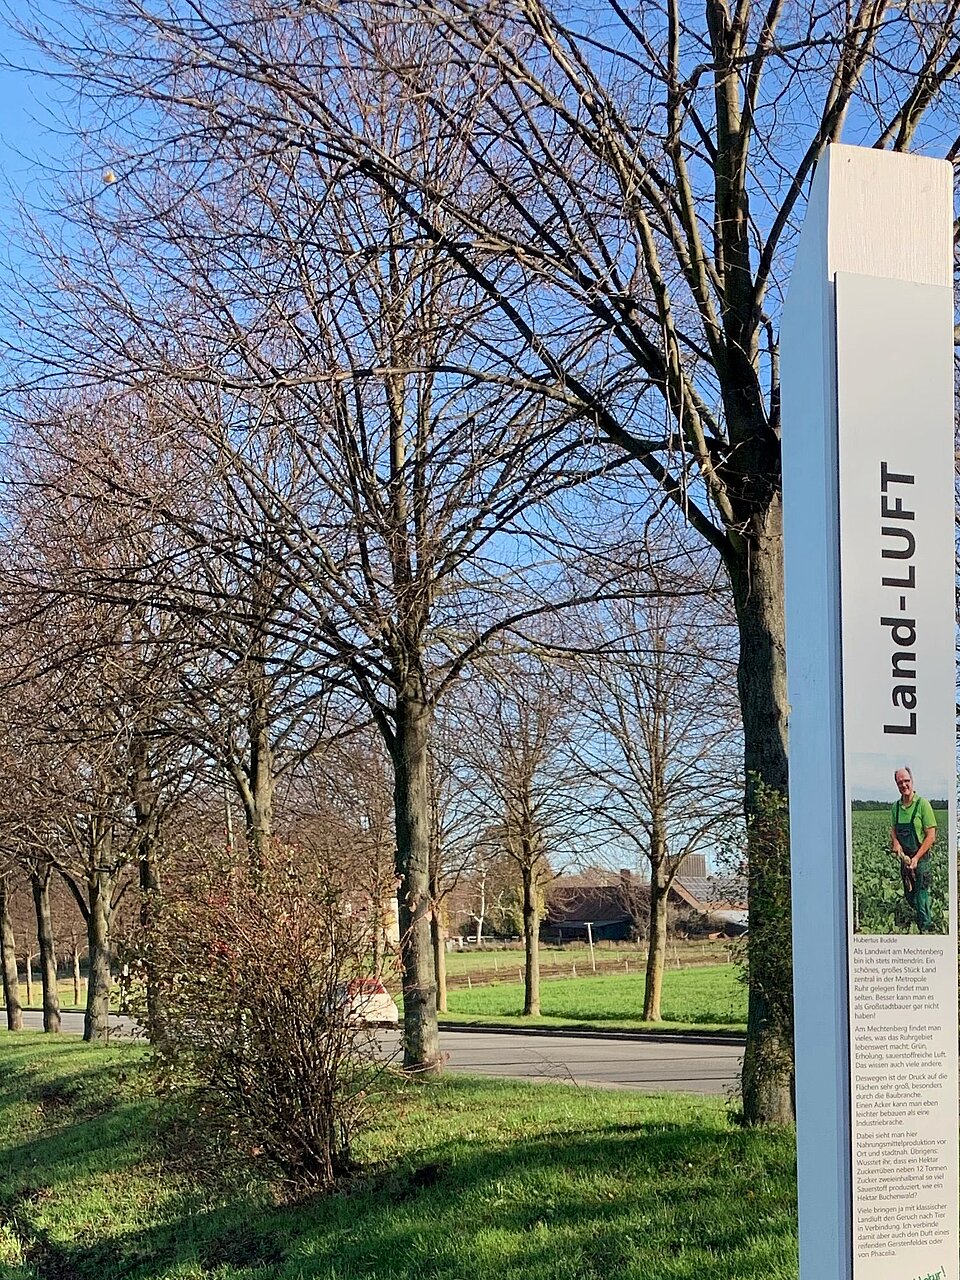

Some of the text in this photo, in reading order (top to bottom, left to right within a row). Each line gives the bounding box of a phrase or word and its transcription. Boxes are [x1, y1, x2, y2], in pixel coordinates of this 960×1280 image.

[880, 461, 917, 735] Land-LUFT
[857, 1140, 935, 1149] Nahrungsmittelproduktion
[857, 1167, 894, 1175] Zuckerrüben
